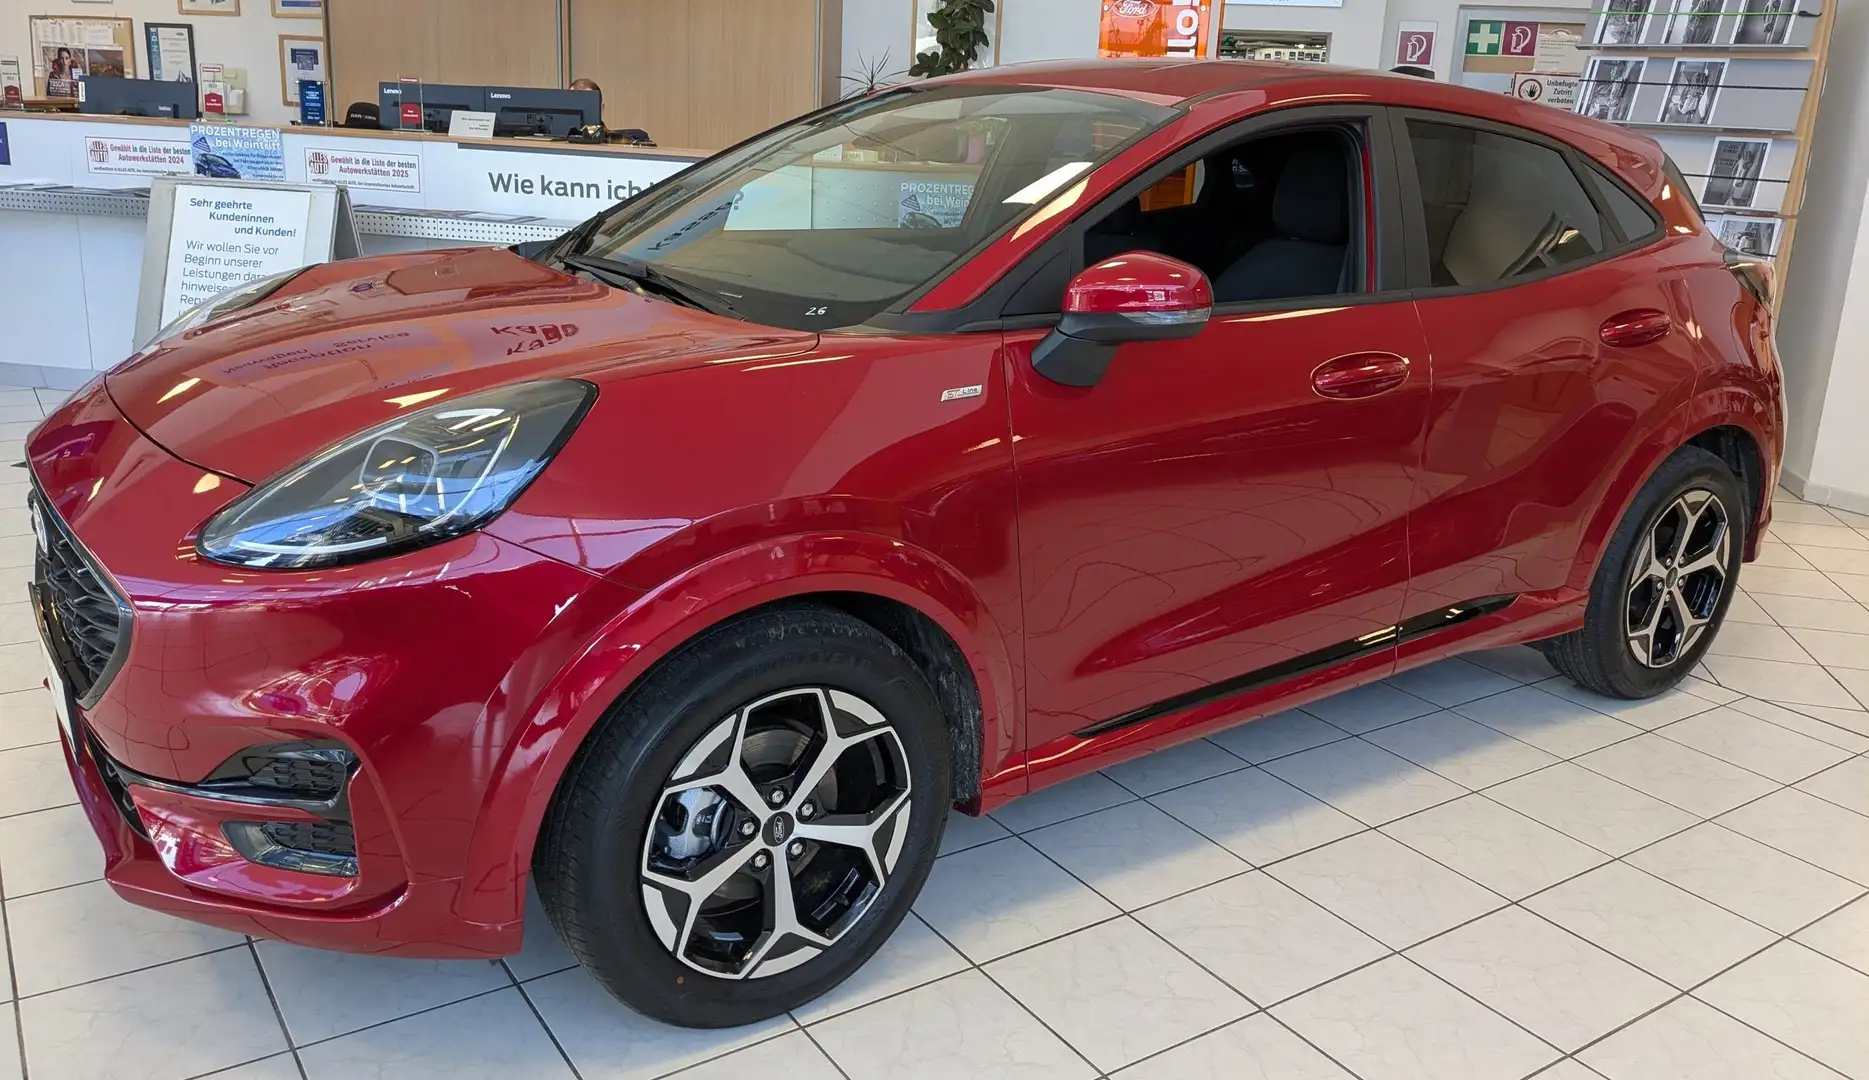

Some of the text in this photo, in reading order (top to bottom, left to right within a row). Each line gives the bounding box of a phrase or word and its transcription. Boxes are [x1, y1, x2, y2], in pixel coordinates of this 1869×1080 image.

[1119, 0, 1148, 15] Ford
[1546, 80, 1579, 88] Unbefugte
[383, 87, 402, 95] Lenovo
[190, 125, 280, 140] PROZENTREGEN
[109, 143, 191, 156] Gewählt in die Liste der besten
[215, 138, 231, 148] bei
[118, 153, 185, 164] Autowerkstätten 2024
[330, 155, 417, 169] Gewählt in die Liste der besten
[338, 165, 409, 178] Autowerkstätten 2025
[488, 172, 534, 195] Wie
[540, 175, 600, 199] kann
[607, 180, 643, 201] ich
[190, 197, 253, 210] Sehr geehrte
[926, 194, 943, 206] bei
[208, 211, 275, 224] Kundeninnen
[234, 226, 297, 237] und Kunden!
[186, 240, 279, 256] Wir wollen Sie vor
[184, 253, 263, 269] Beginn unserer
[182, 267, 241, 282] Leistungen
[180, 280, 232, 293] hinweise
[179, 294, 206, 305] Rep
